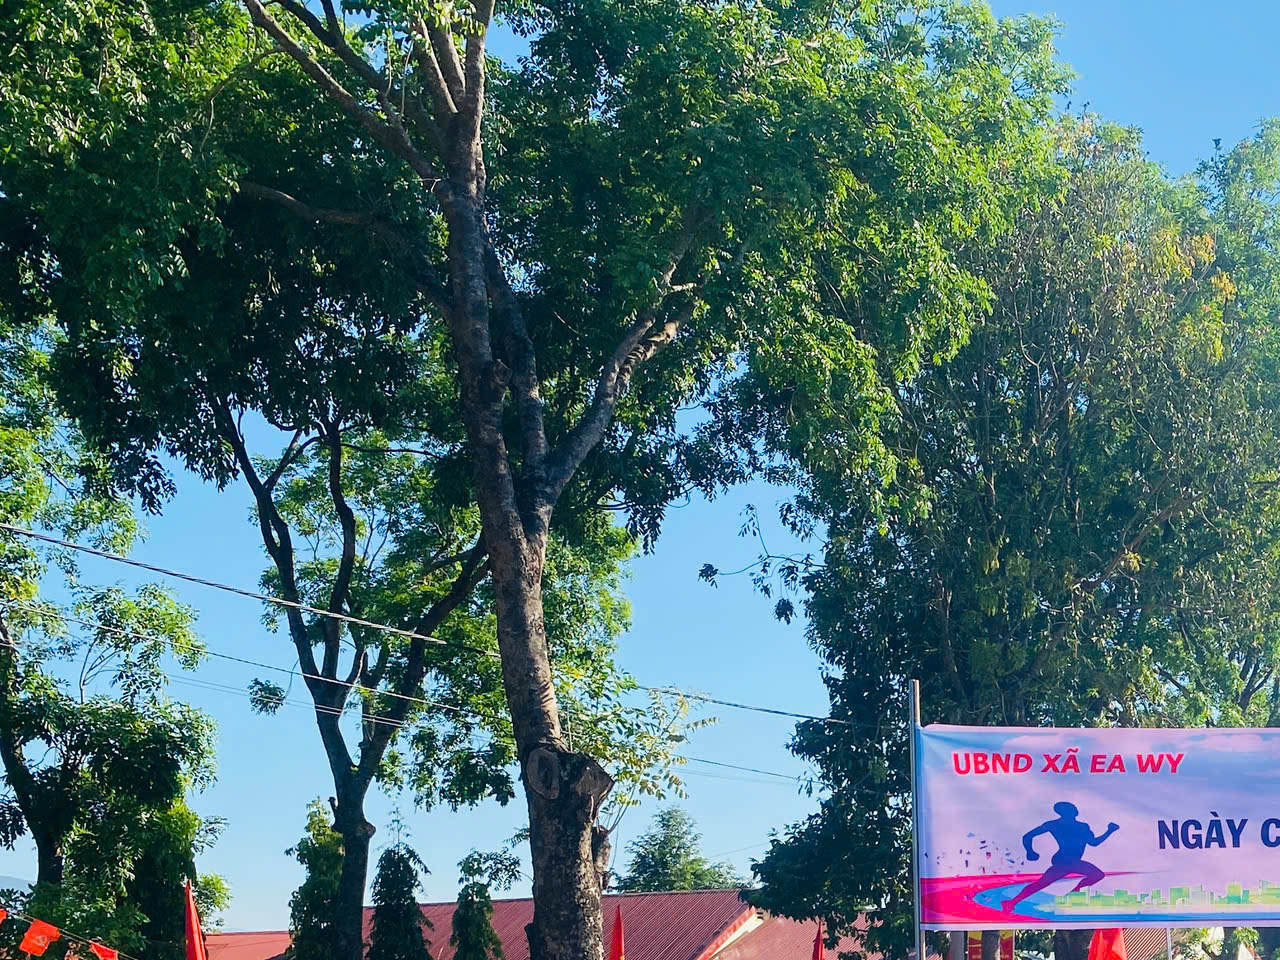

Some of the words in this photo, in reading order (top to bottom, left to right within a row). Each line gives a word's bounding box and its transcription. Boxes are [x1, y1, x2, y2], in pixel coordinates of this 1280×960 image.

[953, 753, 1033, 775] UBND
[1041, 747, 1081, 773] XÃ
[1090, 754, 1126, 773] EA
[1136, 753, 1184, 773] WY
[1157, 811, 1248, 849] NGÀY
